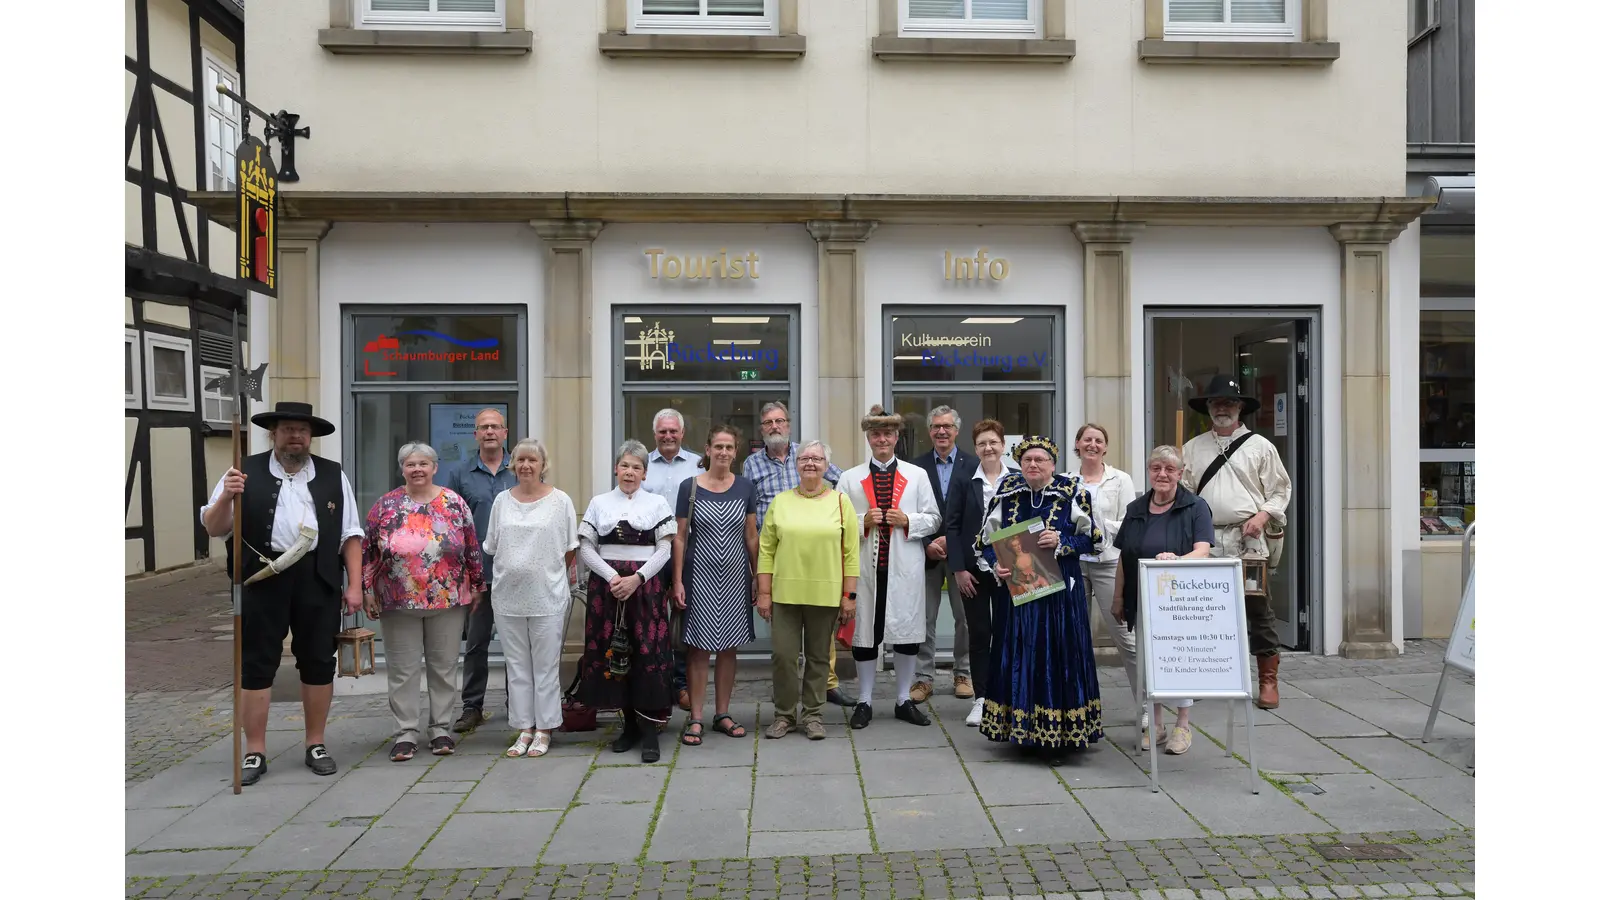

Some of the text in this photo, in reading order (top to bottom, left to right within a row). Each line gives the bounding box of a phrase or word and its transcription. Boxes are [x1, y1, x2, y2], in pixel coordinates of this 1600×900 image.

[644, 248, 1009, 281] Tourist Info
[901, 333, 992, 348] Kulturverein
[382, 350, 499, 363] Schaumburger Land
[667, 341, 779, 371] Bückeburg
[921, 349, 1049, 373] Bückeburg e.V.
[1171, 579, 1230, 593] Bückeburg
[1152, 634, 1185, 642] Samstags
